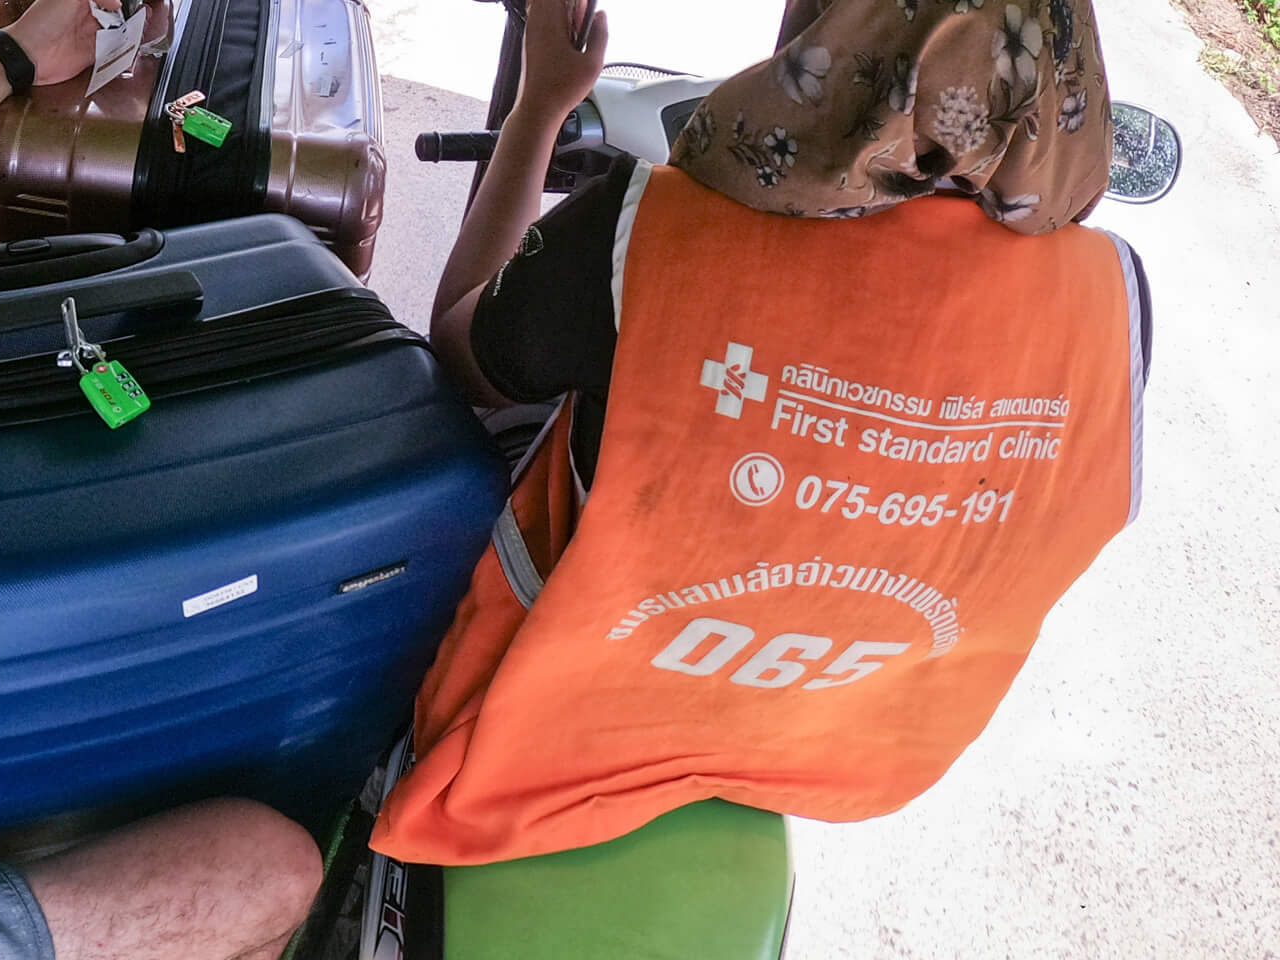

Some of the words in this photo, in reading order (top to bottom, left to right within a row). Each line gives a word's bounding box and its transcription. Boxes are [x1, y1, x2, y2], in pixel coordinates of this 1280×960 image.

[781, 362, 933, 417] คลินิกเวชกรรม
[770, 397, 848, 448] First
[858, 427, 994, 464] standard
[998, 429, 1062, 460] clinic
[794, 474, 1016, 528] 075-695-191
[650, 617, 912, 690] 065
